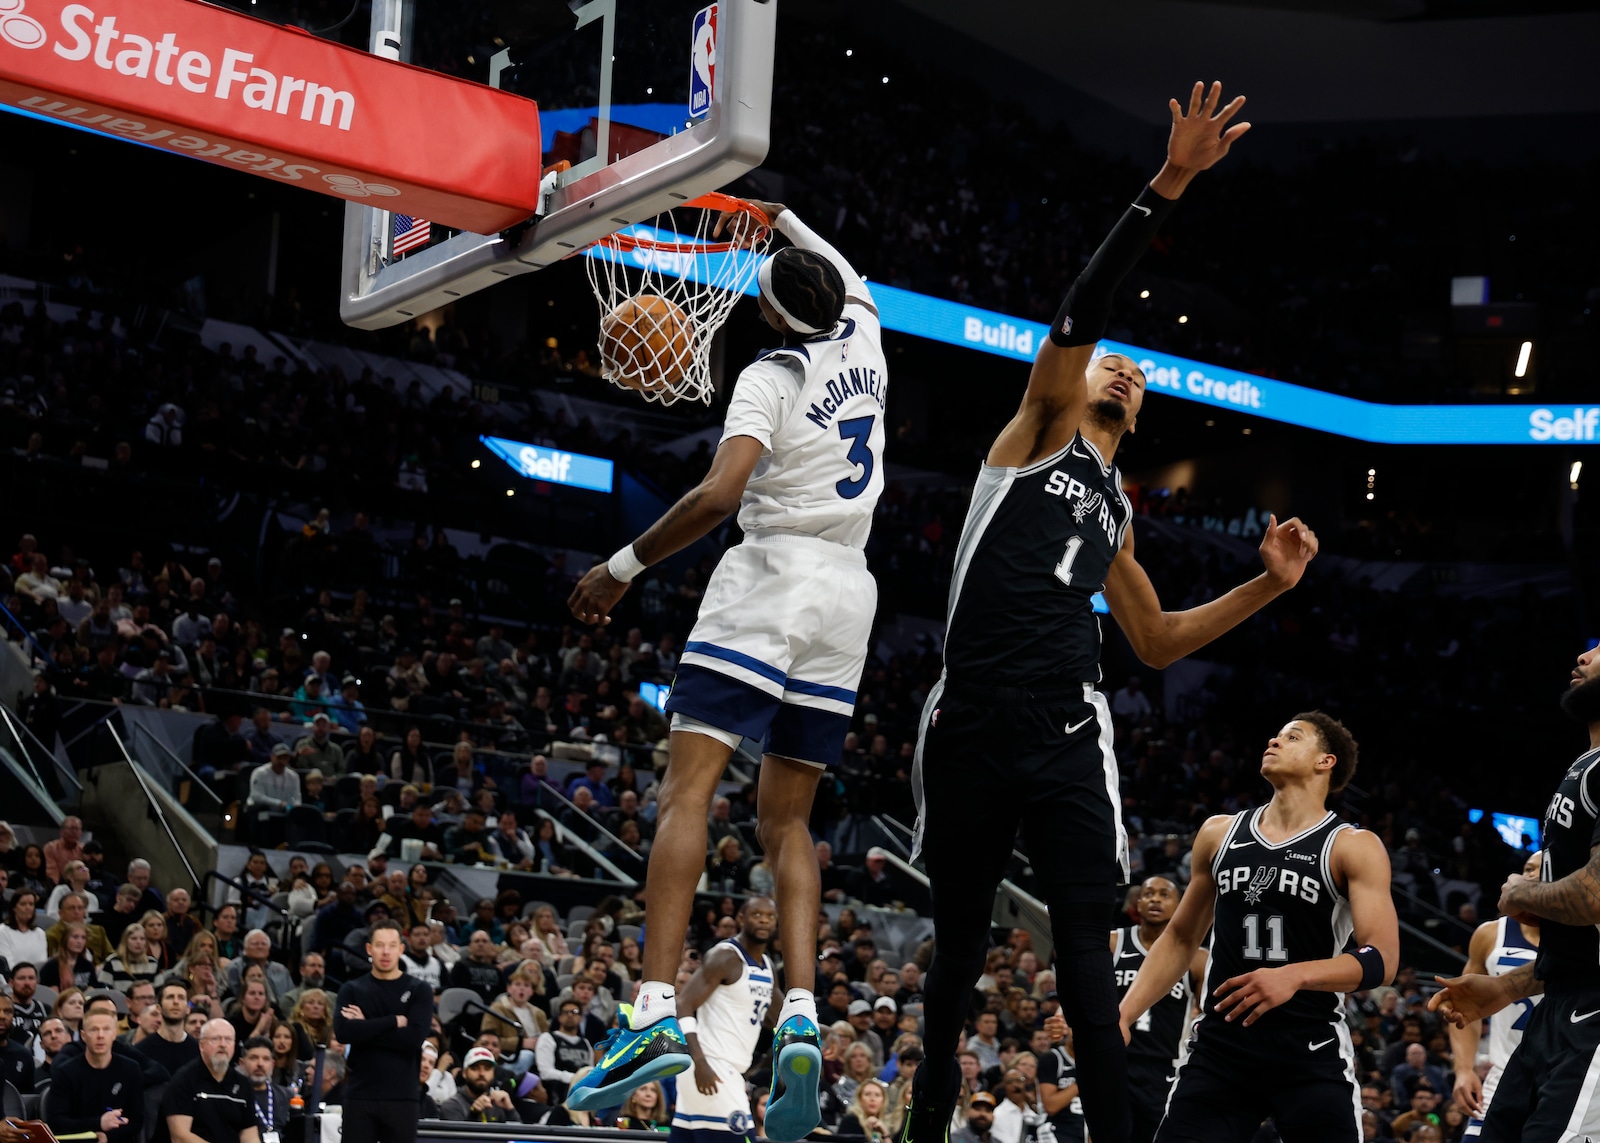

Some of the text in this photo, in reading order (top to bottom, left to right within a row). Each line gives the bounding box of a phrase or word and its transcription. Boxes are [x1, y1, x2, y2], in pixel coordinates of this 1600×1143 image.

[693, 89, 707, 110] NBA
[964, 316, 1033, 355] Build
[805, 367, 887, 430] McDANIELS
[1139, 359, 1261, 409] Get Credit
[1529, 408, 1600, 441] Self
[519, 446, 572, 481] Self
[835, 414, 877, 500] 3
[1054, 535, 1084, 587] 1
[1217, 866, 1321, 905] SPURS
[1242, 914, 1289, 962] 11
